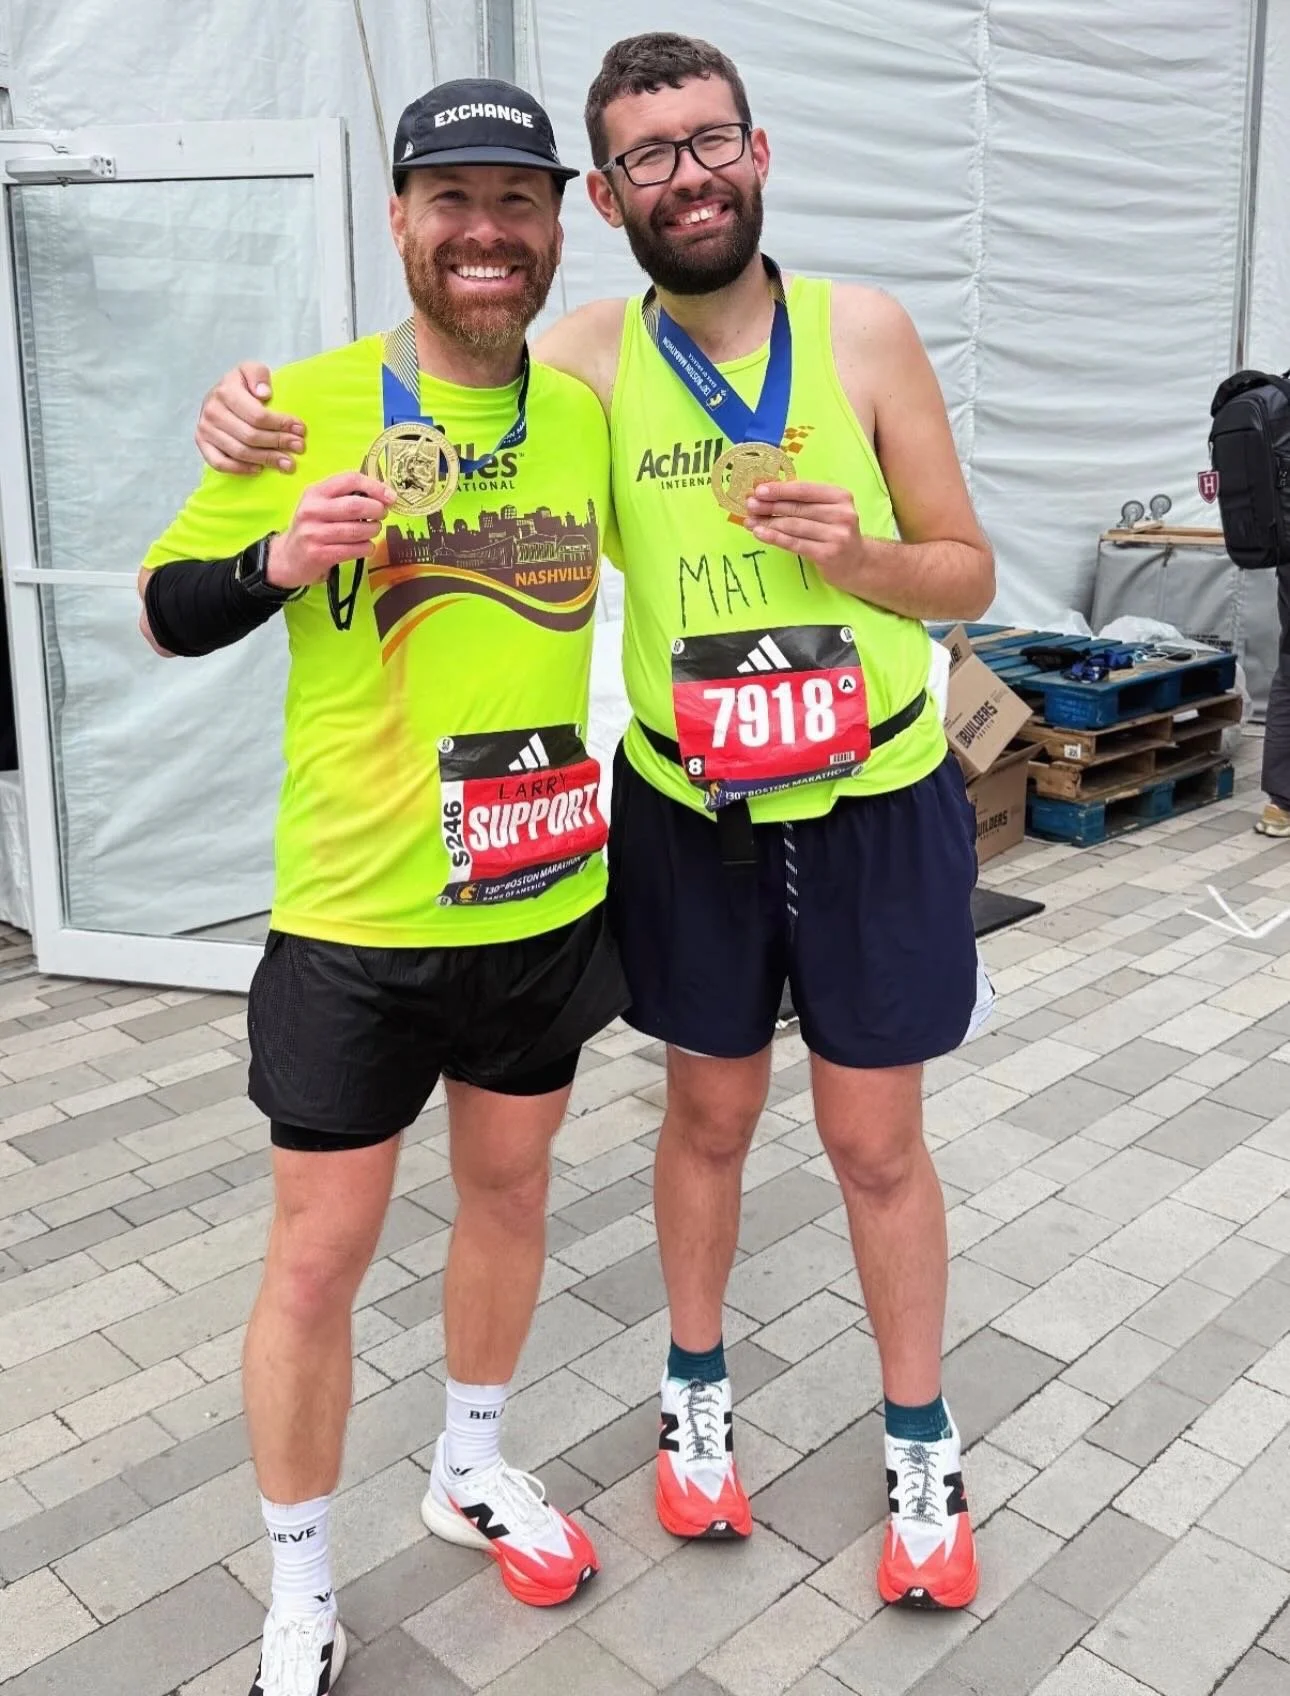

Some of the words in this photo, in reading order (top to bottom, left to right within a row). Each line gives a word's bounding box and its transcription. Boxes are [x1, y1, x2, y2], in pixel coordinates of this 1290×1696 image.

[434, 103, 534, 129] EXCHANGE
[662, 335, 688, 368] MARATHON
[636, 437, 724, 482] Achill
[1203, 476, 1215, 494] H
[515, 565, 593, 587] NASHVILLE
[842, 678, 853, 690] A
[703, 677, 837, 748] 7918
[958, 699, 998, 746] BUILDERS
[687, 757, 702, 775] 8
[498, 773, 568, 800] LARRY
[748, 782, 789, 797] BOSTON
[468, 782, 598, 852] SUPPORT
[977, 810, 1008, 837] UILDERS
[443, 800, 471, 867] S246
[505, 871, 540, 890] BOSTON
